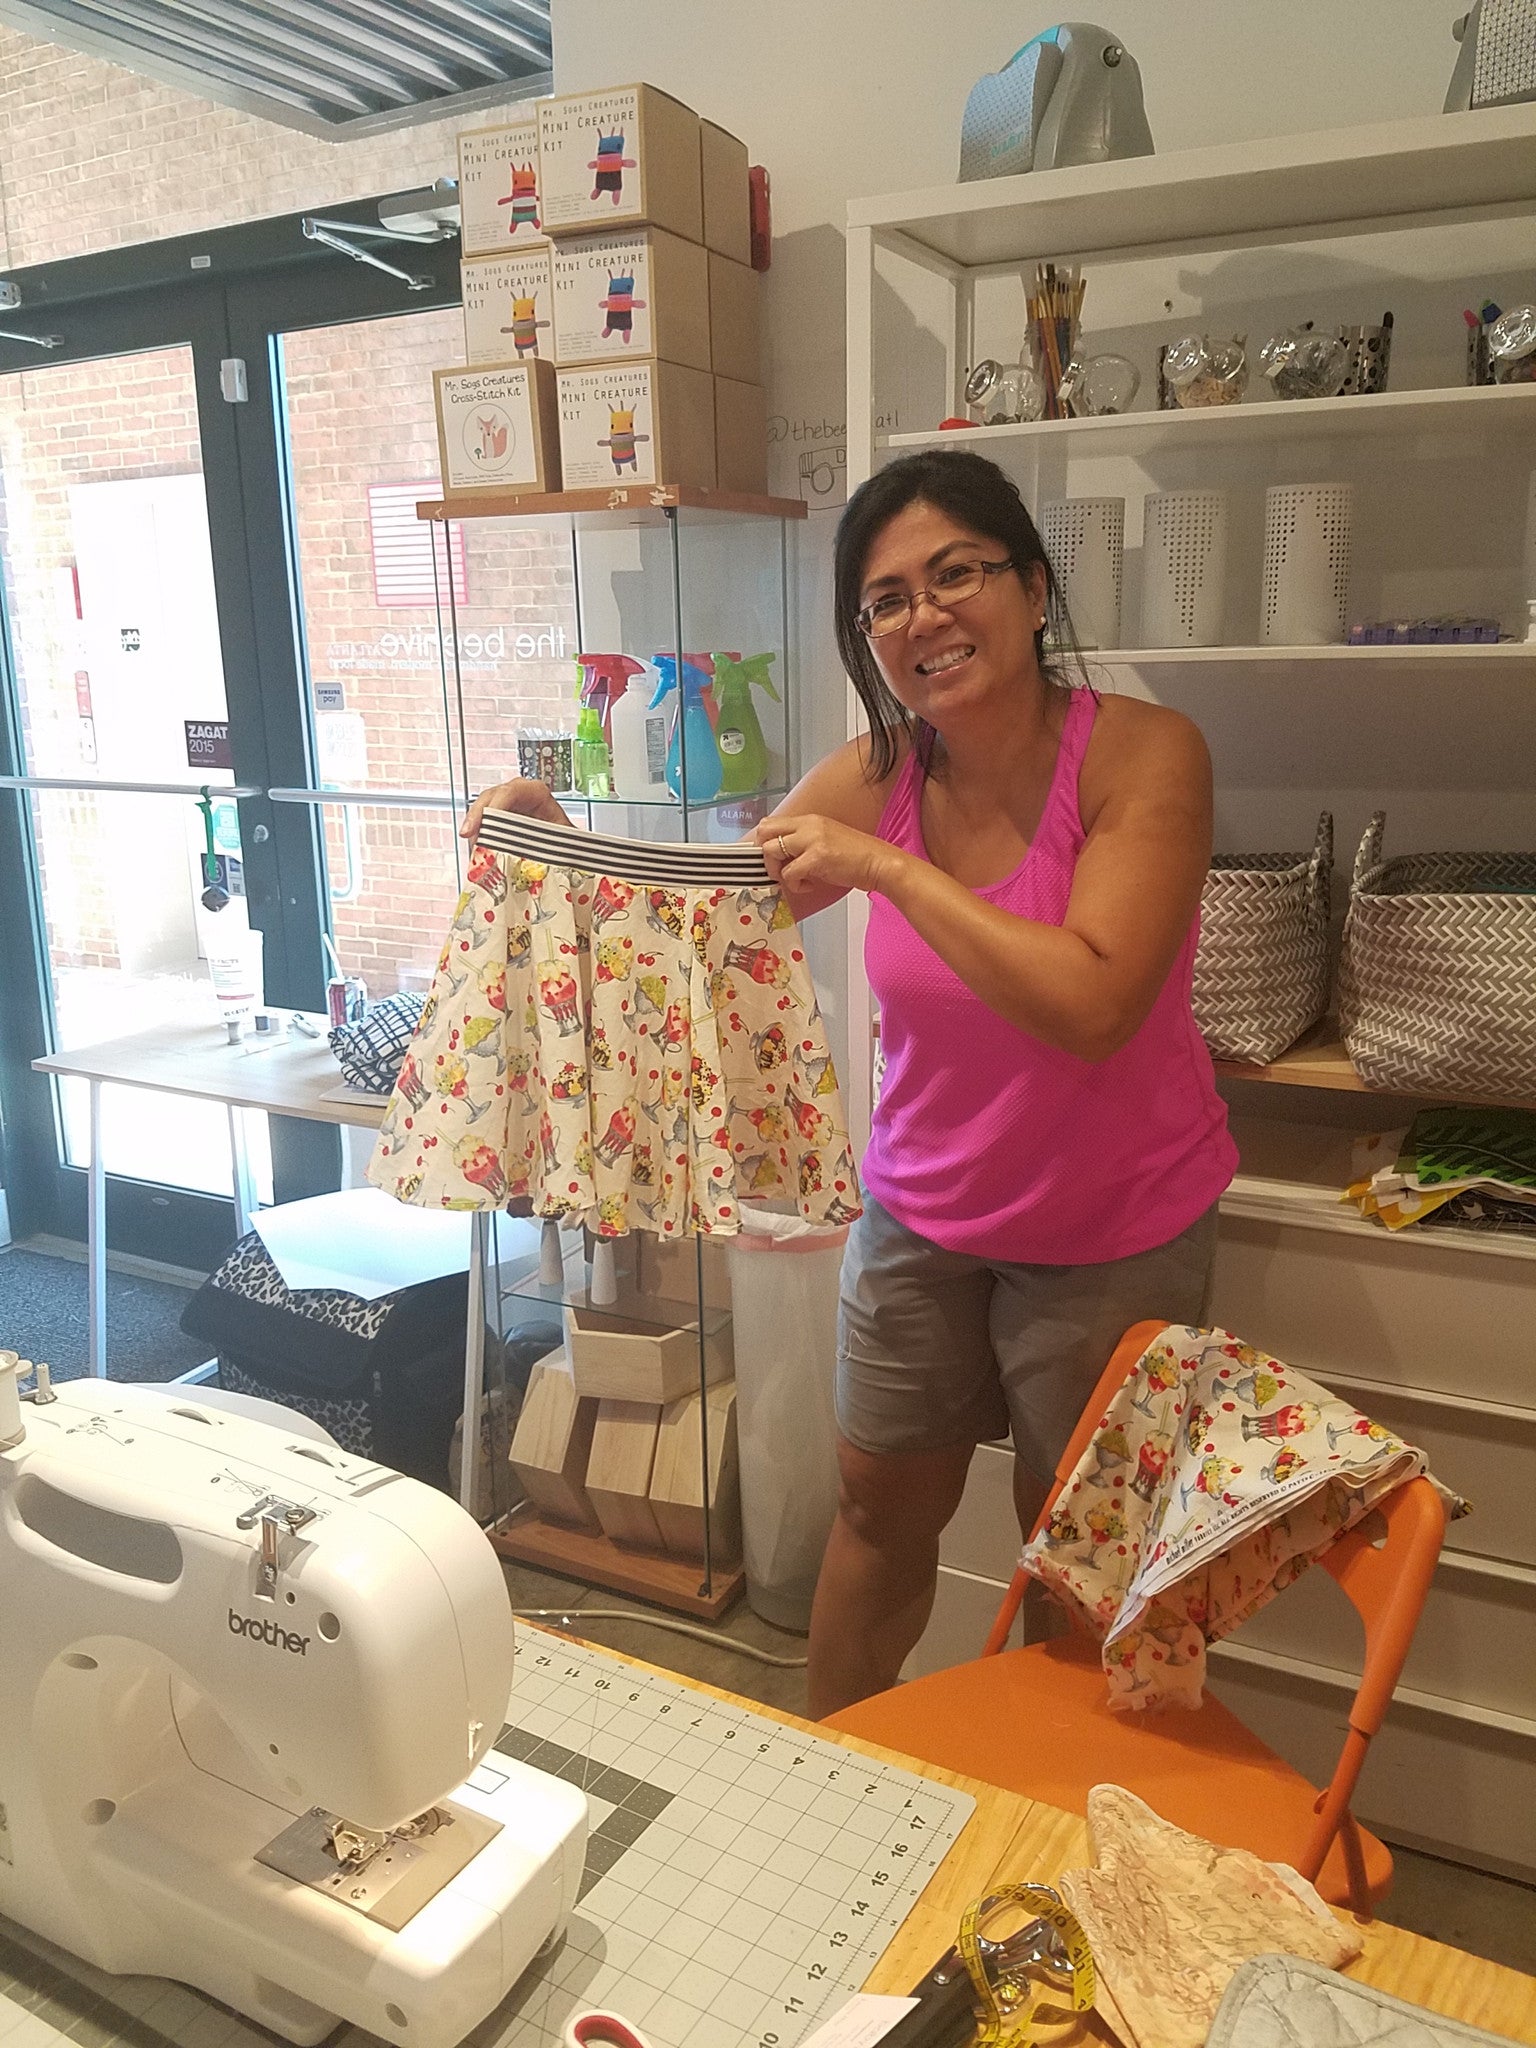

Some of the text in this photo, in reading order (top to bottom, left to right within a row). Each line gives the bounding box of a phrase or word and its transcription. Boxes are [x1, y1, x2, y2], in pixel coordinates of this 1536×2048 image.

[588, 96, 634, 110] CREATURES
[543, 110, 634, 134] MINI CREATURE
[504, 132, 537, 143] CREATUR
[543, 141, 562, 152] KIT
[464, 145, 538, 165] MINI CREATUR
[465, 172, 481, 182] KIT
[599, 239, 644, 251] CREATURES
[506, 261, 548, 273] CREATURES
[555, 253, 644, 273] MINI CREATURE
[466, 274, 548, 292] MINI CREATURE
[556, 280, 574, 291] KIT
[467, 300, 484, 309] KIT
[444, 374, 525, 391] Mr. Sogs Creatures
[604, 373, 648, 384] CREATURES
[451, 387, 521, 404] Cross-Stitch Kit
[561, 386, 648, 403] MINI CREATURE
[563, 411, 581, 420] KIT
[187, 725, 228, 739] ZAGAT
[189, 739, 215, 753] 2015
[721, 809, 753, 820] ALARM
[228, 1608, 311, 1656] brother
[535, 1655, 552, 1667] 12
[564, 1667, 581, 1678] 11
[595, 1679, 612, 1691] 10
[628, 1692, 640, 1702] 9
[660, 1705, 671, 1714] 8
[691, 1718, 702, 1727] 7
[724, 1730, 736, 1740] 6
[758, 1743, 770, 1753] 5
[793, 1756, 805, 1766] 4
[828, 1770, 840, 1780] 3
[864, 1784, 878, 1794] 2
[904, 1799, 913, 1809] 1
[784, 1996, 804, 2015] 11
[807, 1963, 828, 1981] 12
[829, 1931, 848, 1948] 13
[851, 1900, 870, 1917] 14
[871, 1870, 889, 1887] 15
[891, 1843, 909, 1858] 16
[909, 1815, 926, 1830] 17
